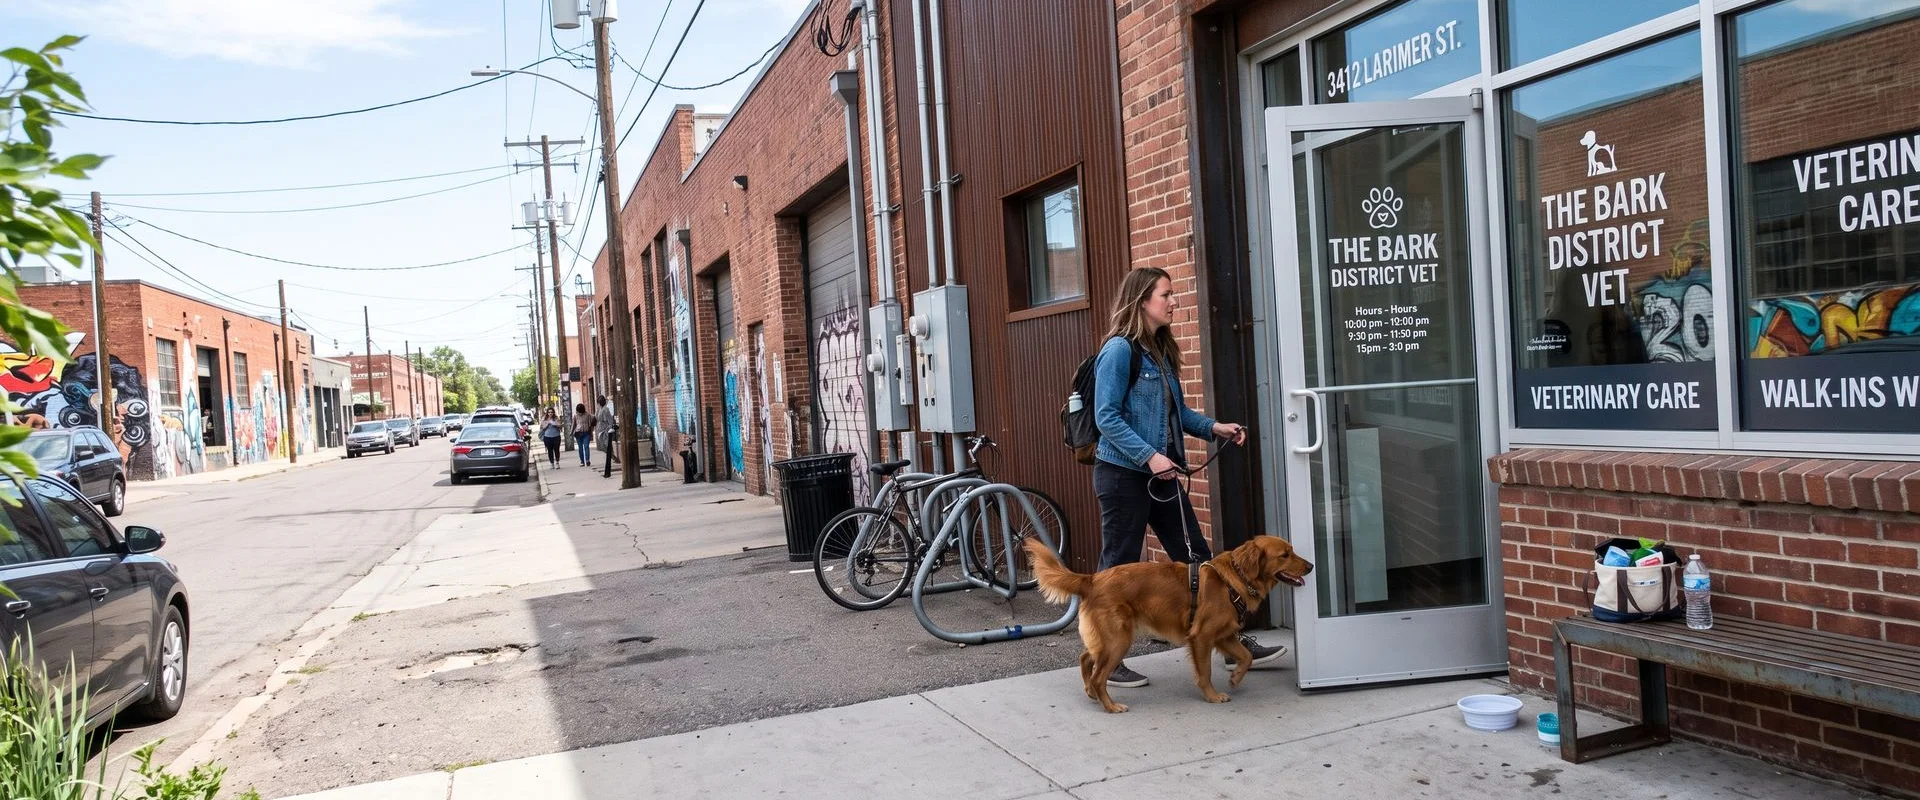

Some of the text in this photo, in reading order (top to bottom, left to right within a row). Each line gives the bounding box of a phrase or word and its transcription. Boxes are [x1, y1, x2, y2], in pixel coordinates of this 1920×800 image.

[1327, 20, 1462, 98] 3412 LARIMER ST.
[1792, 134, 1920, 193] VETERIN
[1541, 172, 1668, 230] THE BARK
[1839, 184, 1920, 233] CARE
[1328, 233, 1439, 264] THE BARK
[1548, 218, 1664, 271] DISTRICT
[1331, 263, 1438, 288] DISTRICT VET
[1582, 268, 1629, 308] VET
[1344, 319, 1367, 329] 10:00
[1369, 320, 1382, 329] pm
[1415, 317, 1430, 327] pm
[1355, 306, 1382, 316] Hours
[1390, 304, 1418, 314] Hours
[1356, 344, 1381, 354] 15pm
[1388, 342, 1404, 351] 3:0
[1405, 342, 1420, 352] pm
[1368, 332, 1382, 342] pm
[1390, 329, 1411, 339] 11:50
[1413, 329, 1427, 339] pm
[1530, 381, 1700, 410] VETERINARY CARE
[1760, 376, 1886, 408] WALK-INS
